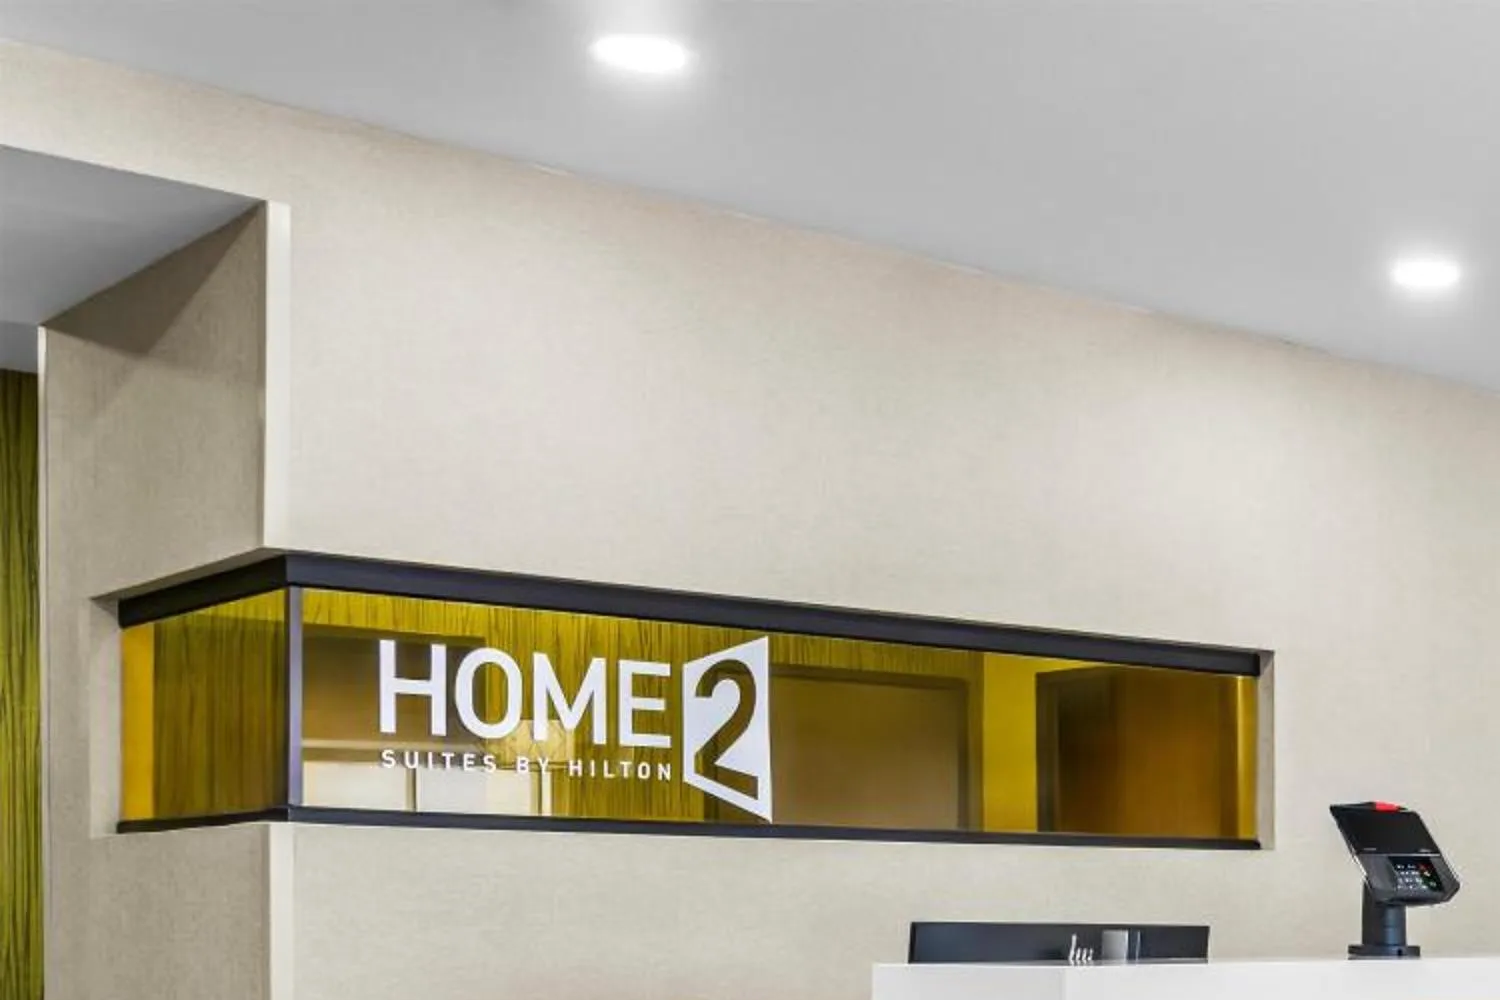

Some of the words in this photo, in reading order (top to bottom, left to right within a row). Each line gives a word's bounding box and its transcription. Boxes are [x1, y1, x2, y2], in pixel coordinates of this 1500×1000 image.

[379, 638, 673, 749] HOME
[380, 749, 498, 774] SUITES
[516, 757, 551, 774] BY
[569, 759, 673, 782] HILTON
